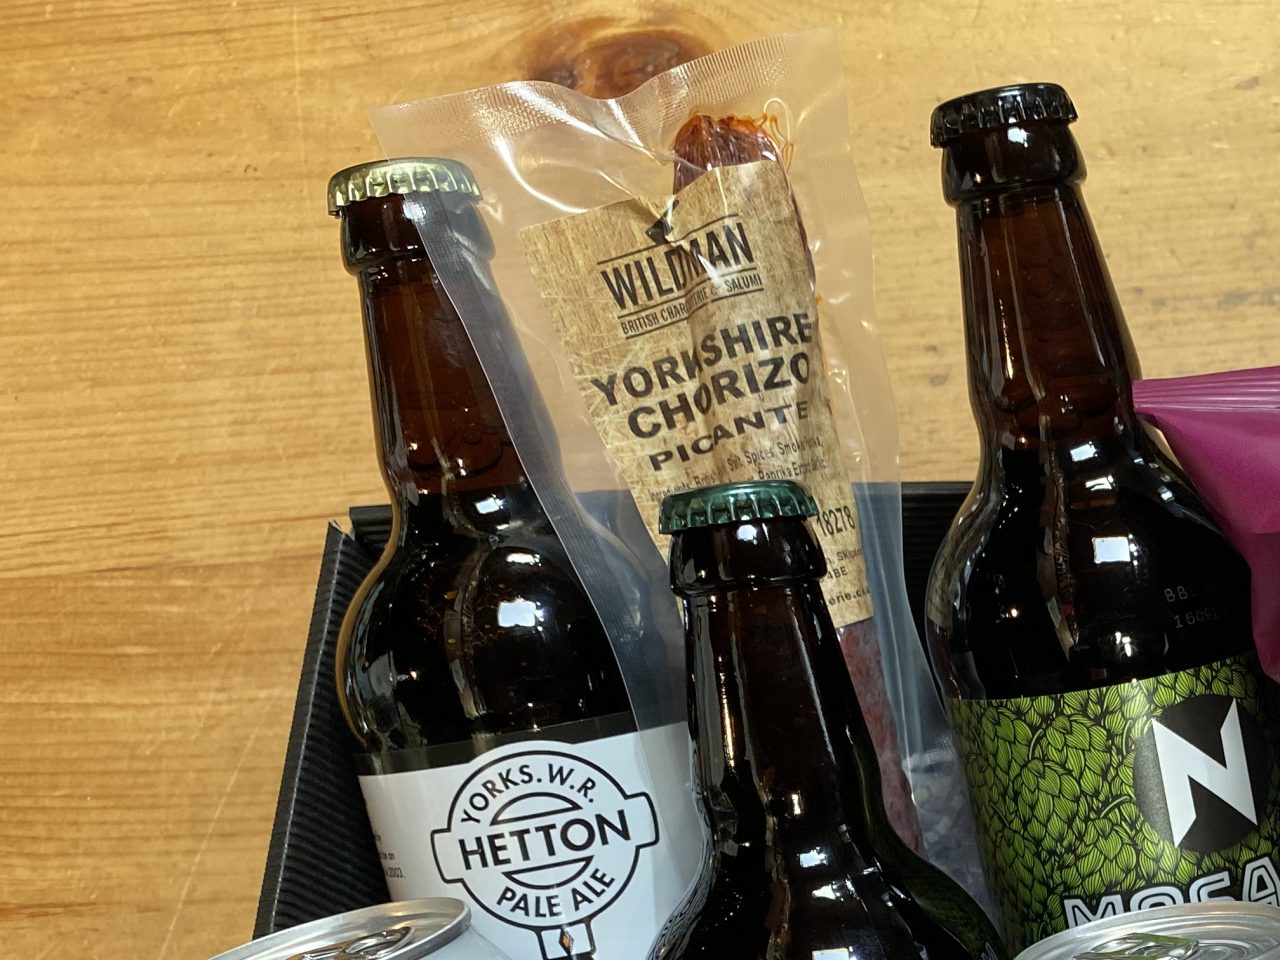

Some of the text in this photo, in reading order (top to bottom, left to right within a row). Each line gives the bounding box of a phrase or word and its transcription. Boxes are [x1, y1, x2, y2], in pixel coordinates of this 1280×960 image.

[600, 222, 755, 310] WILDMAN
[620, 314, 661, 336] BRITISH
[724, 273, 763, 293] SALUMI
[590, 312, 813, 407] YORKSHIRE
[627, 352, 811, 440] CHORIZO
[649, 400, 810, 473] PICANTE
[816, 505, 856, 538] 18278
[1151, 697, 1258, 849] N
[458, 808, 632, 872] HETTON
[496, 867, 616, 918] PALE ALE
